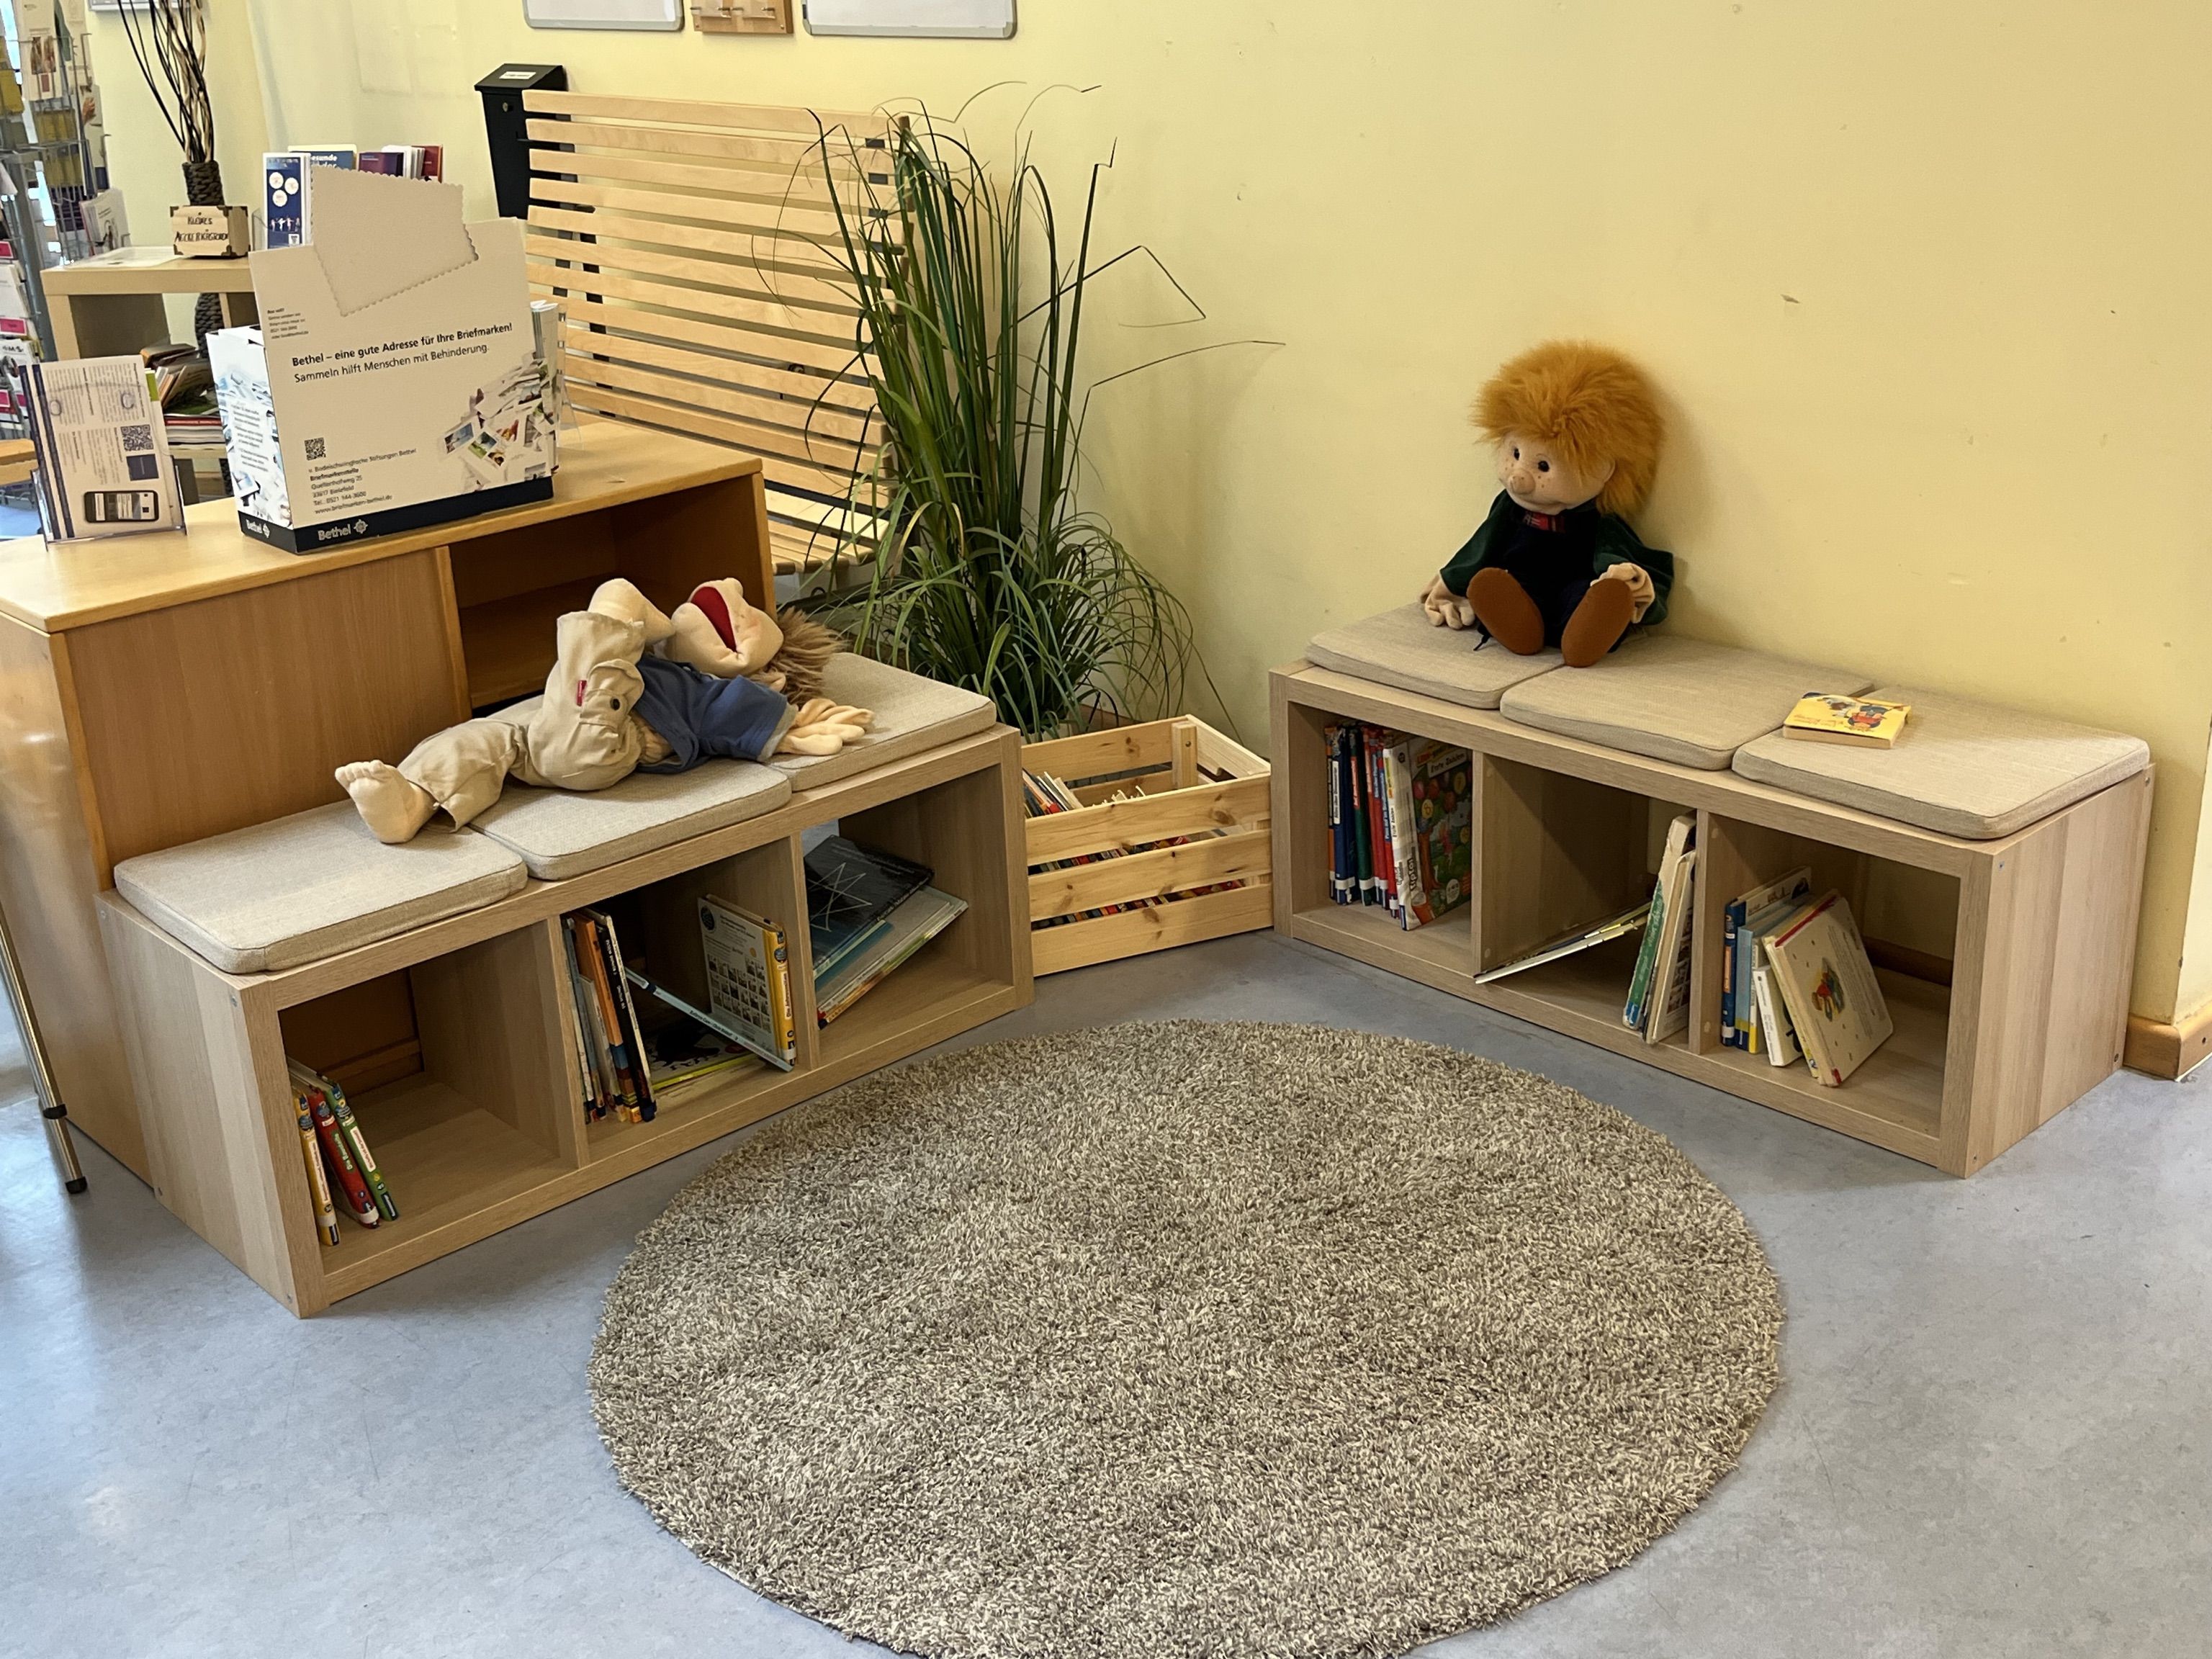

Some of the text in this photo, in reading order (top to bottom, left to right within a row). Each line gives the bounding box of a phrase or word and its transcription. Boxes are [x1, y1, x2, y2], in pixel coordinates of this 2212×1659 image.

[292, 353, 324, 367] Bethel
[335, 350, 355, 360] eine
[358, 346, 380, 359] gute
[382, 340, 418, 352] Adresse
[421, 336, 434, 346] für
[436, 333, 454, 343] Ihre
[457, 323, 513, 340] Briefmarken!
[294, 344, 490, 383] Sammeln hilft Menschen mit Behinderung.
[318, 524, 351, 541] Bethel
